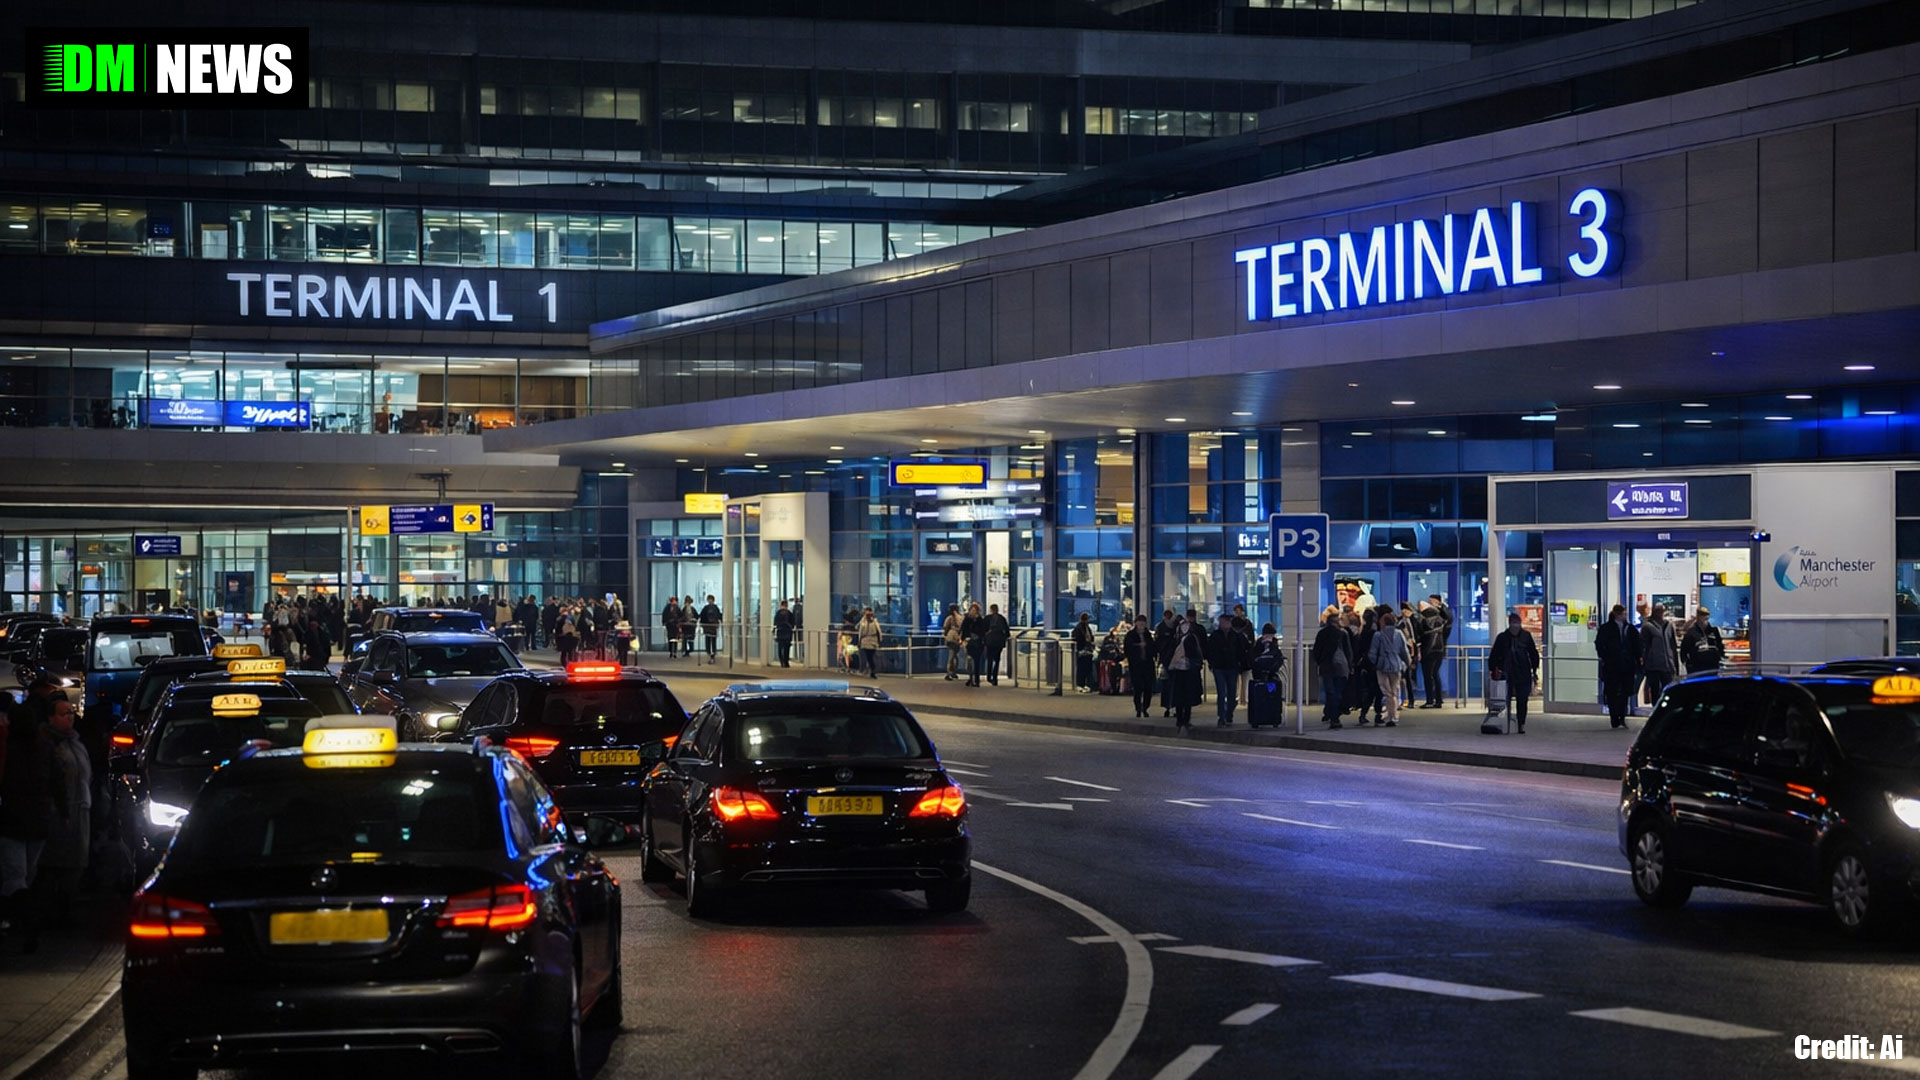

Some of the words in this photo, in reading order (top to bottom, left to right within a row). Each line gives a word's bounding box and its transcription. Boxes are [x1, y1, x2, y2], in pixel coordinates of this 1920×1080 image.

[1235, 201, 1542, 321] TERMINAL
[1567, 188, 1609, 278] 3
[227, 272, 514, 323] TERMINAL
[538, 282, 558, 323] 1
[1278, 528, 1321, 558] P3
[1800, 557, 1876, 572] Manchester
[1799, 574, 1839, 591] Airport
